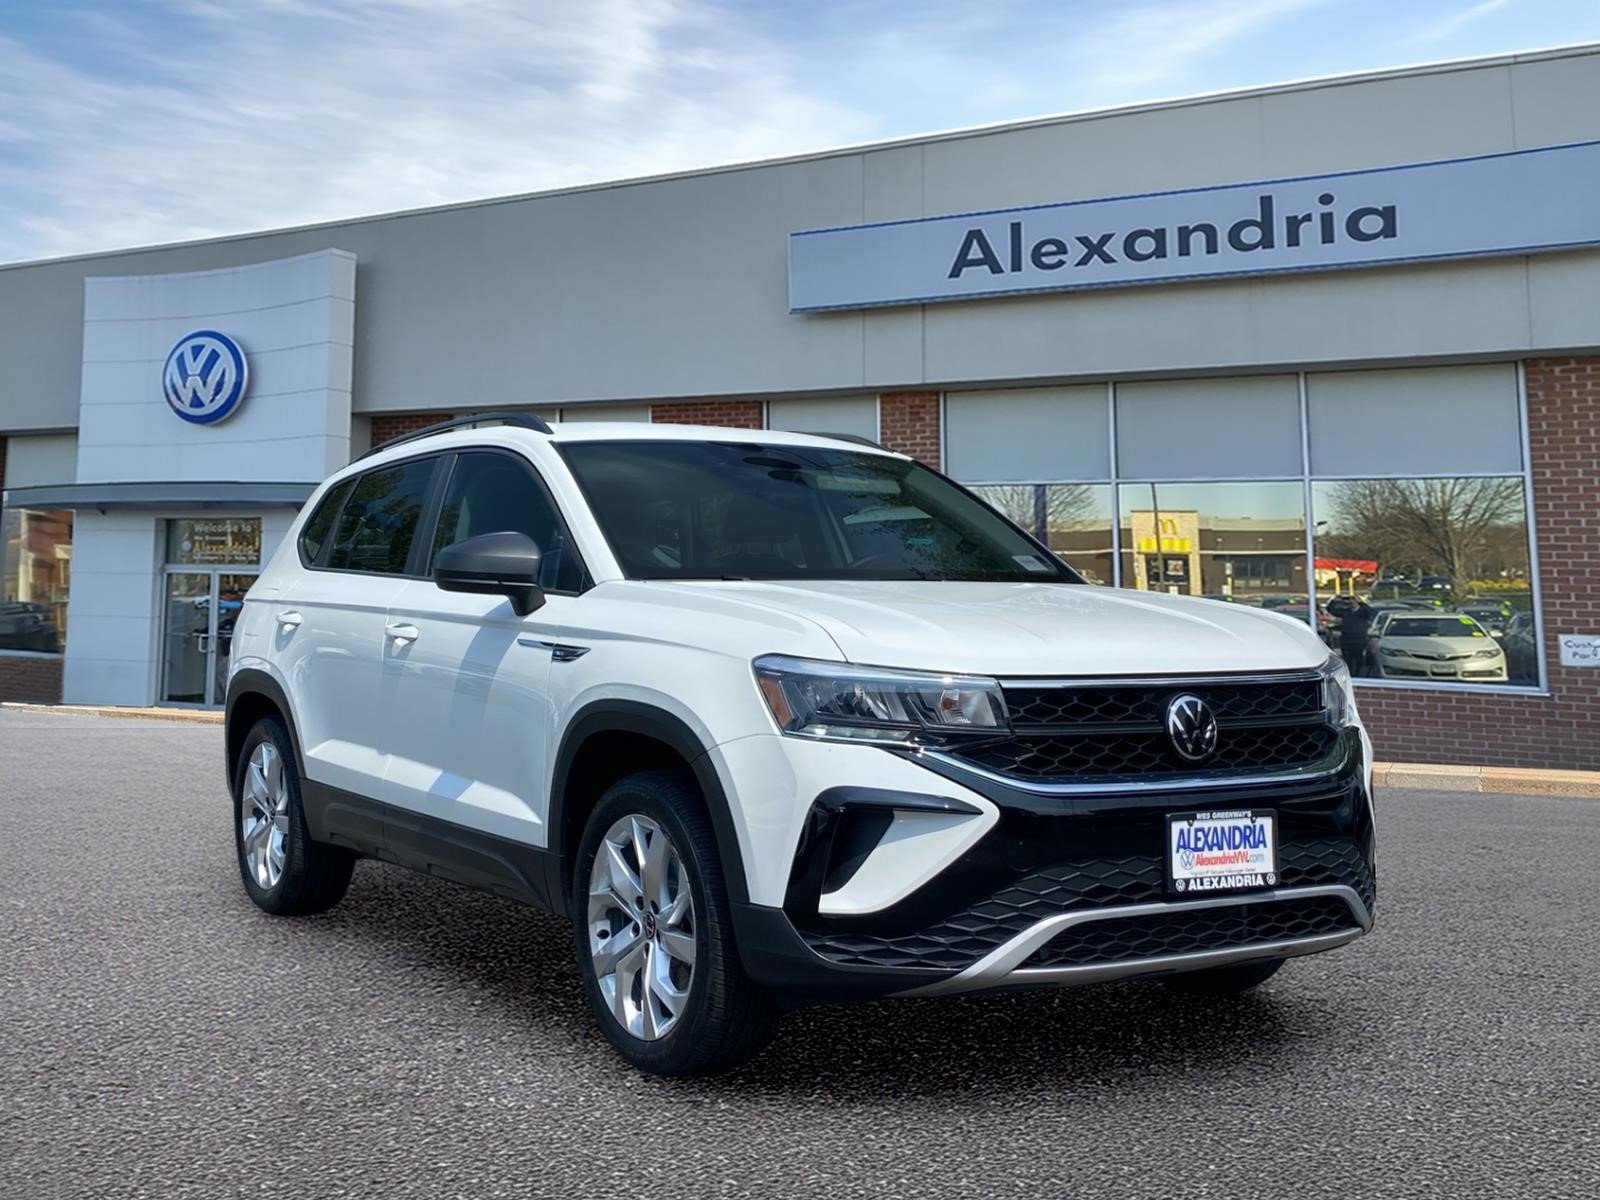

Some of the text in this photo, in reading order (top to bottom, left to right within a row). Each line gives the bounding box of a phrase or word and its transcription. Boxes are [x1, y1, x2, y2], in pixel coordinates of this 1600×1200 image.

[948, 193, 1398, 279] Alexandria
[1176, 823, 1267, 854] ALEXANDRIA
[1188, 873, 1265, 891] ALEXANDRIA
